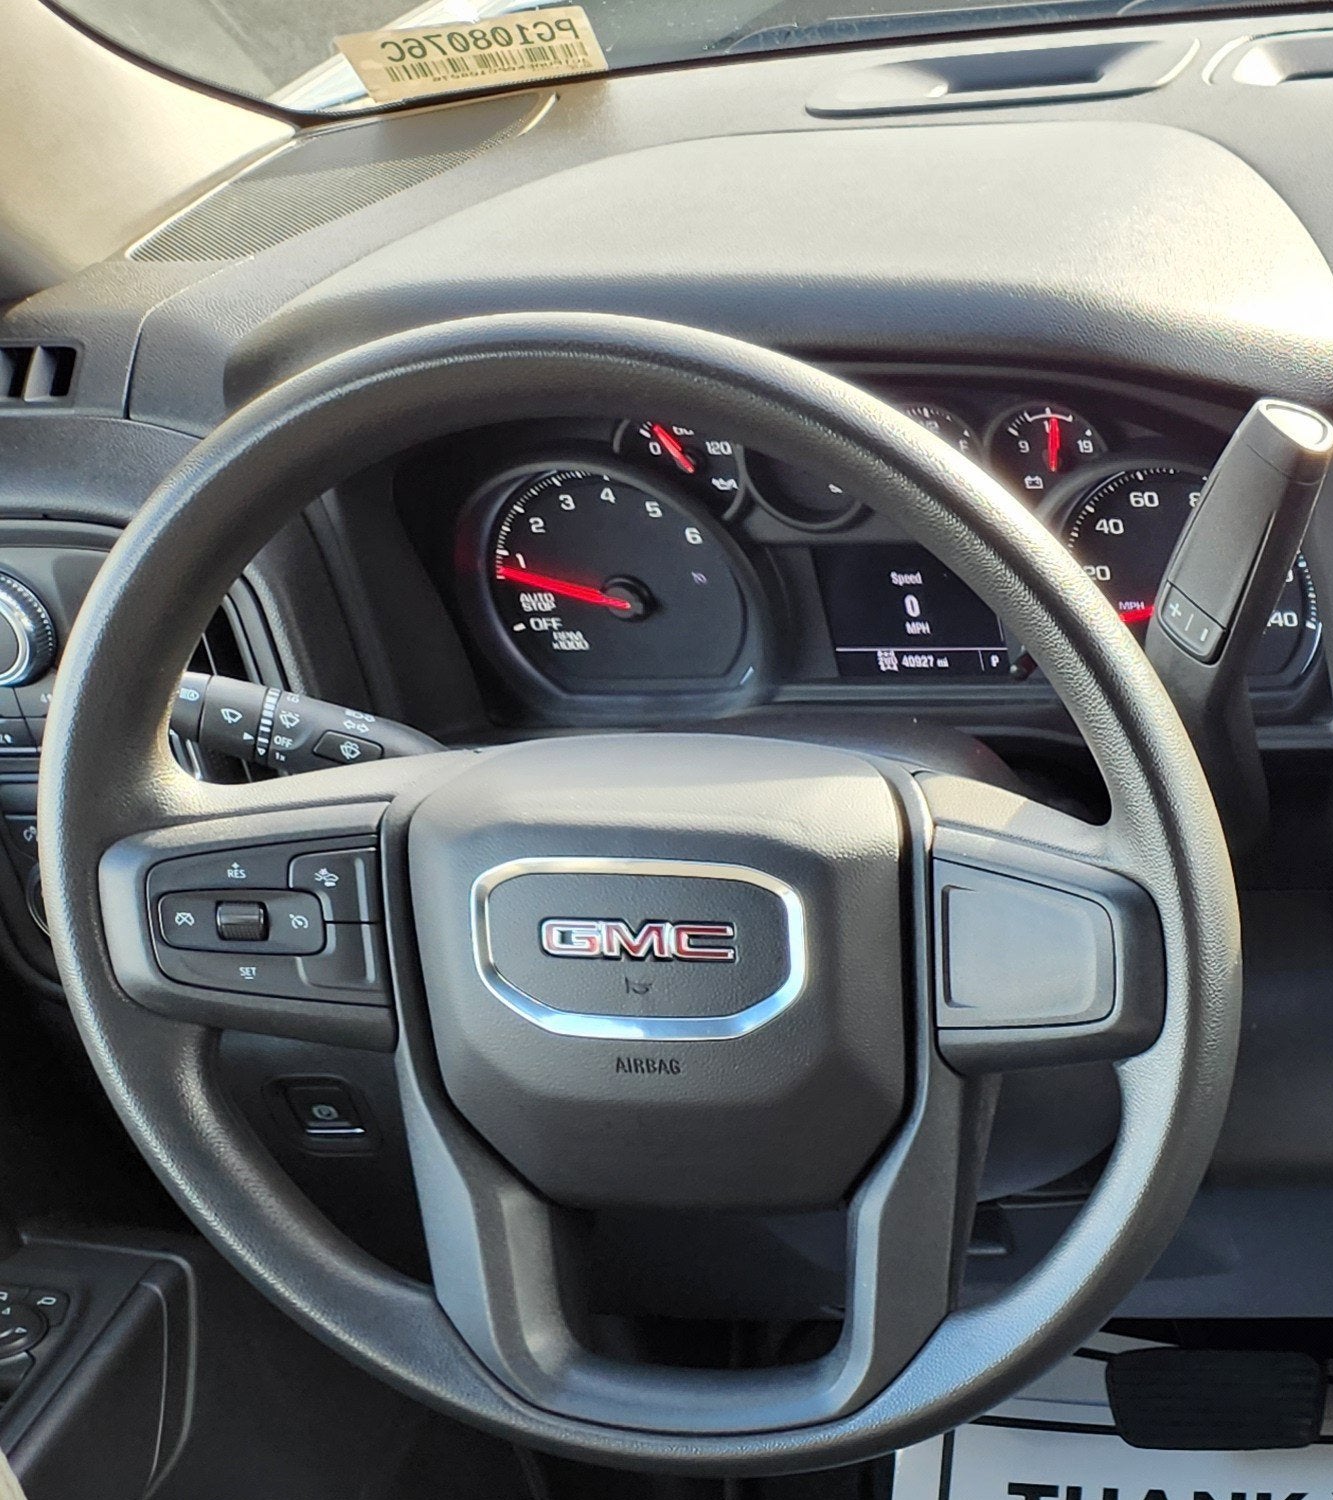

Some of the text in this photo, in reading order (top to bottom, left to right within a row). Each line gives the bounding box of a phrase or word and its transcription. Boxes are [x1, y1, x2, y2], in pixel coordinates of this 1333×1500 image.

[648, 441, 662, 456] 0
[705, 441, 732, 456] 120
[1018, 440, 1030, 454] 9
[1076, 440, 1094, 454] 19
[558, 494, 576, 511] 3
[600, 487, 616, 504] 4
[1129, 491, 1160, 508] 60
[645, 501, 662, 518] 5
[529, 517, 546, 534] 2
[1094, 518, 1125, 535] 40
[684, 527, 703, 545] 6
[515, 552, 526, 569] 1
[890, 570, 923, 587] Speed
[519, 592, 556, 603] AUTO
[521, 601, 557, 612] STOP
[904, 594, 921, 618] 0
[1118, 601, 1146, 611] MPH
[529, 617, 563, 631] OFF
[905, 621, 931, 635] MPH
[901, 654, 935, 668] 40927
[990, 654, 1000, 668] P
[273, 735, 294, 748] OFF
[227, 869, 247, 879] RES
[541, 919, 735, 961] GMC
[239, 966, 257, 977] SET
[615, 1056, 681, 1075] AIRBAG
